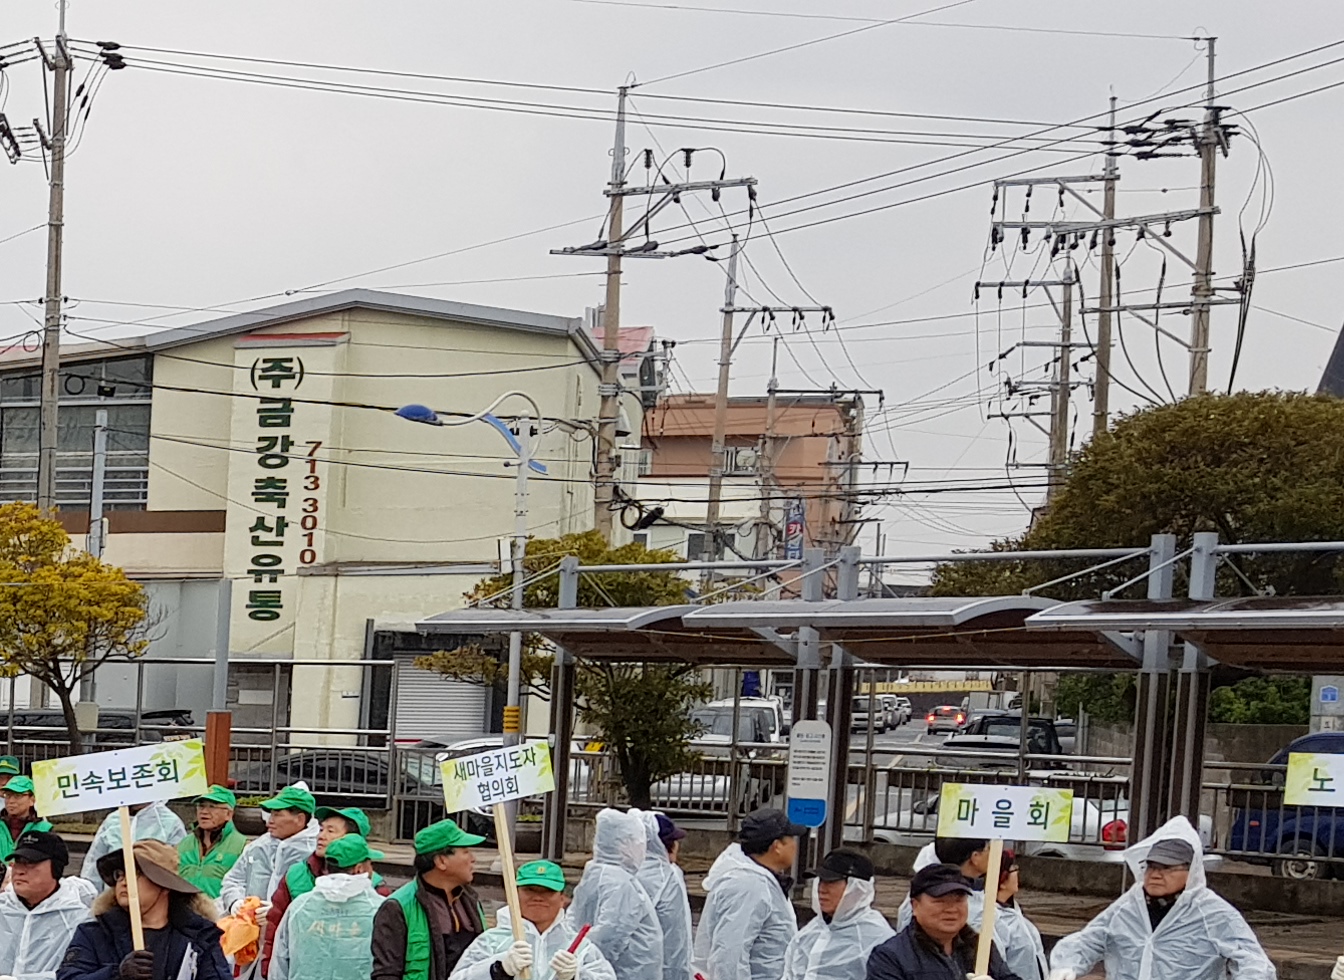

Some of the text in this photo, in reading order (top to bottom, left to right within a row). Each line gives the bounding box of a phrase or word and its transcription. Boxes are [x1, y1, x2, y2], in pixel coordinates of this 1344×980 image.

[57, 758, 179, 799] 민속보존회
[454, 747, 537, 781] 새마을지도자
[477, 775, 520, 802] 협의회
